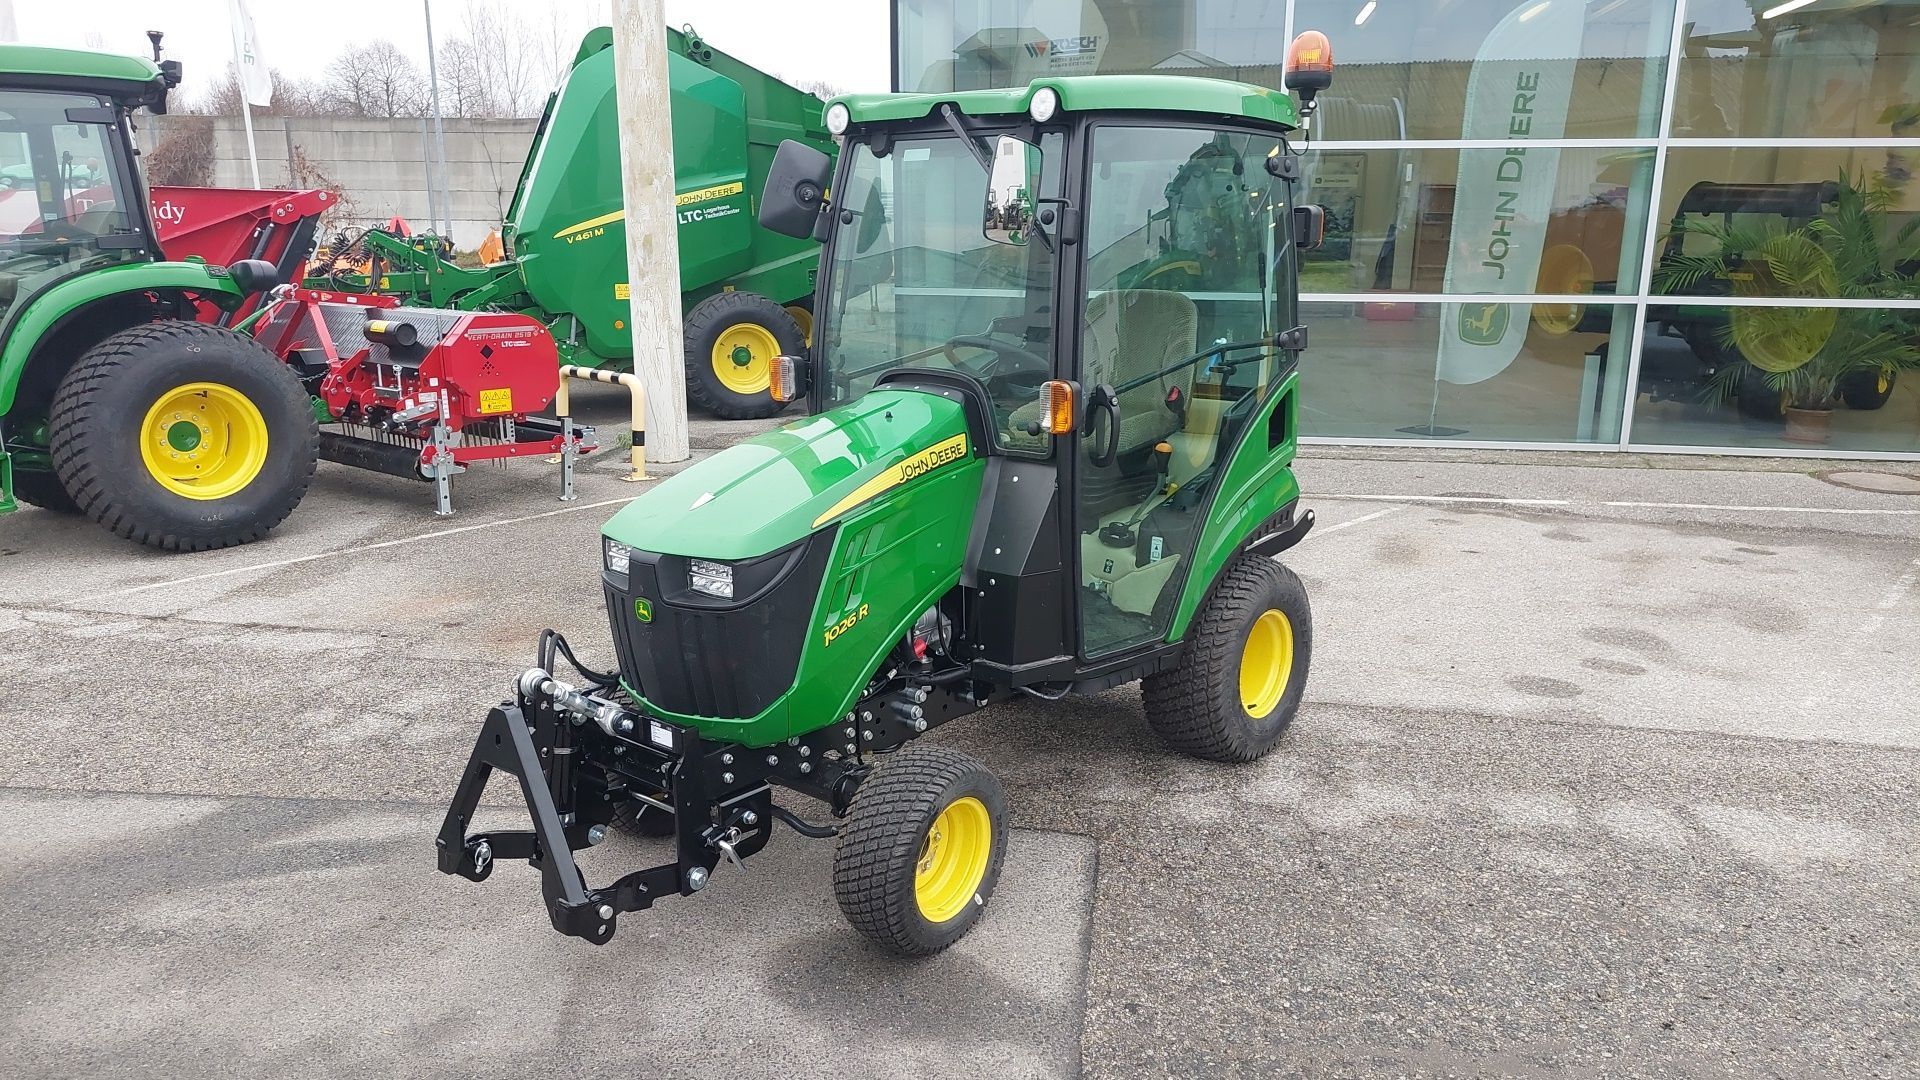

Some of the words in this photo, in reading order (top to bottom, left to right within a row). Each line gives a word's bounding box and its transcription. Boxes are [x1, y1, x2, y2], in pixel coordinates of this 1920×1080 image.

[1496, 71, 1540, 183] DEERE
[677, 192, 703, 205] JOHN
[704, 186, 735, 199] DEERE
[152, 200, 186, 225] idy
[678, 209, 704, 225] LTC
[703, 204, 731, 214] Lagerhaus
[566, 235, 574, 244] V
[575, 230, 593, 241] 461
[594, 227, 604, 237] M
[1482, 191, 1519, 280] JOHN
[501, 340, 514, 348] LTC
[899, 457, 929, 482] JOHN
[928, 442, 962, 467] DEERE
[824, 612, 857, 648] 1026
[859, 603, 869, 621] R
